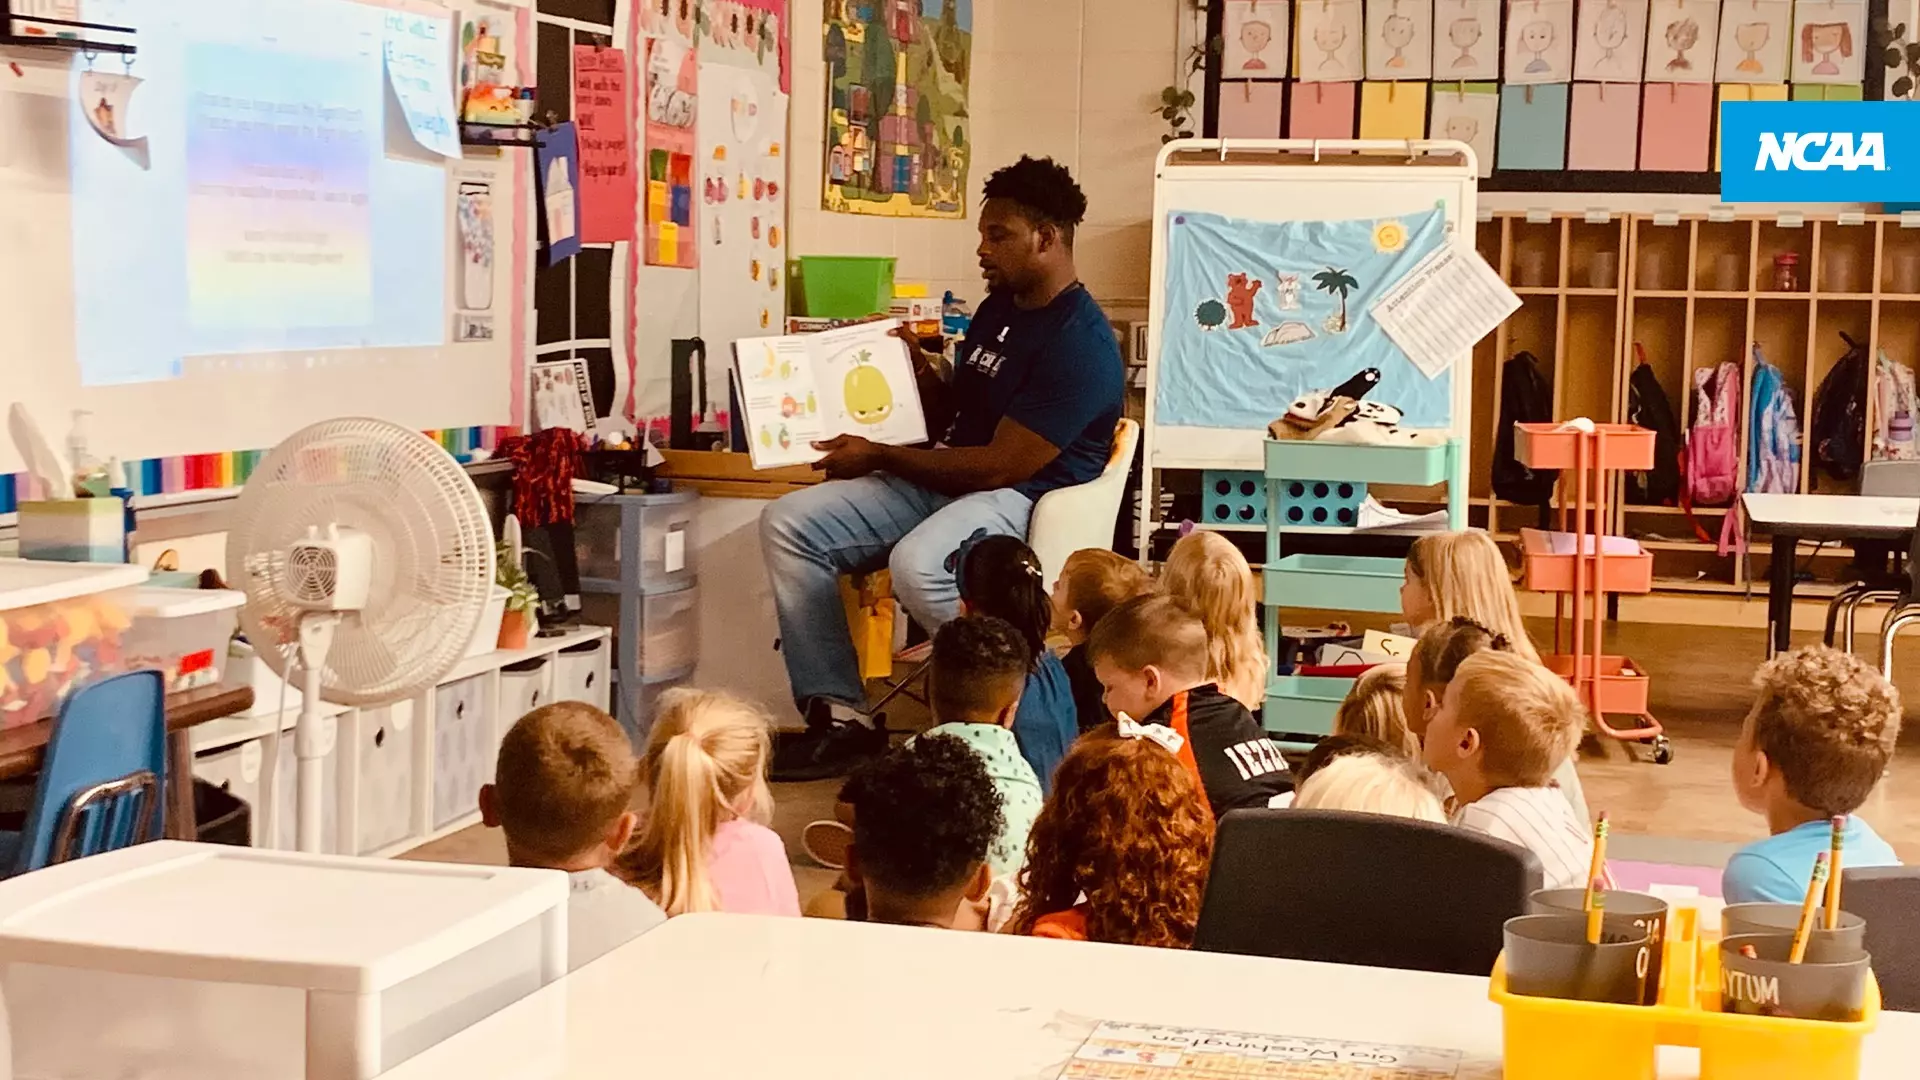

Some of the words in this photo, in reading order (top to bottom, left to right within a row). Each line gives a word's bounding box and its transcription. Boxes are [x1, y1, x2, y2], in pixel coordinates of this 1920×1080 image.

[1386, 276, 1426, 313] Attention
[1152, 1034, 1338, 1059] Washington
[1350, 1051, 1398, 1064] Gia
